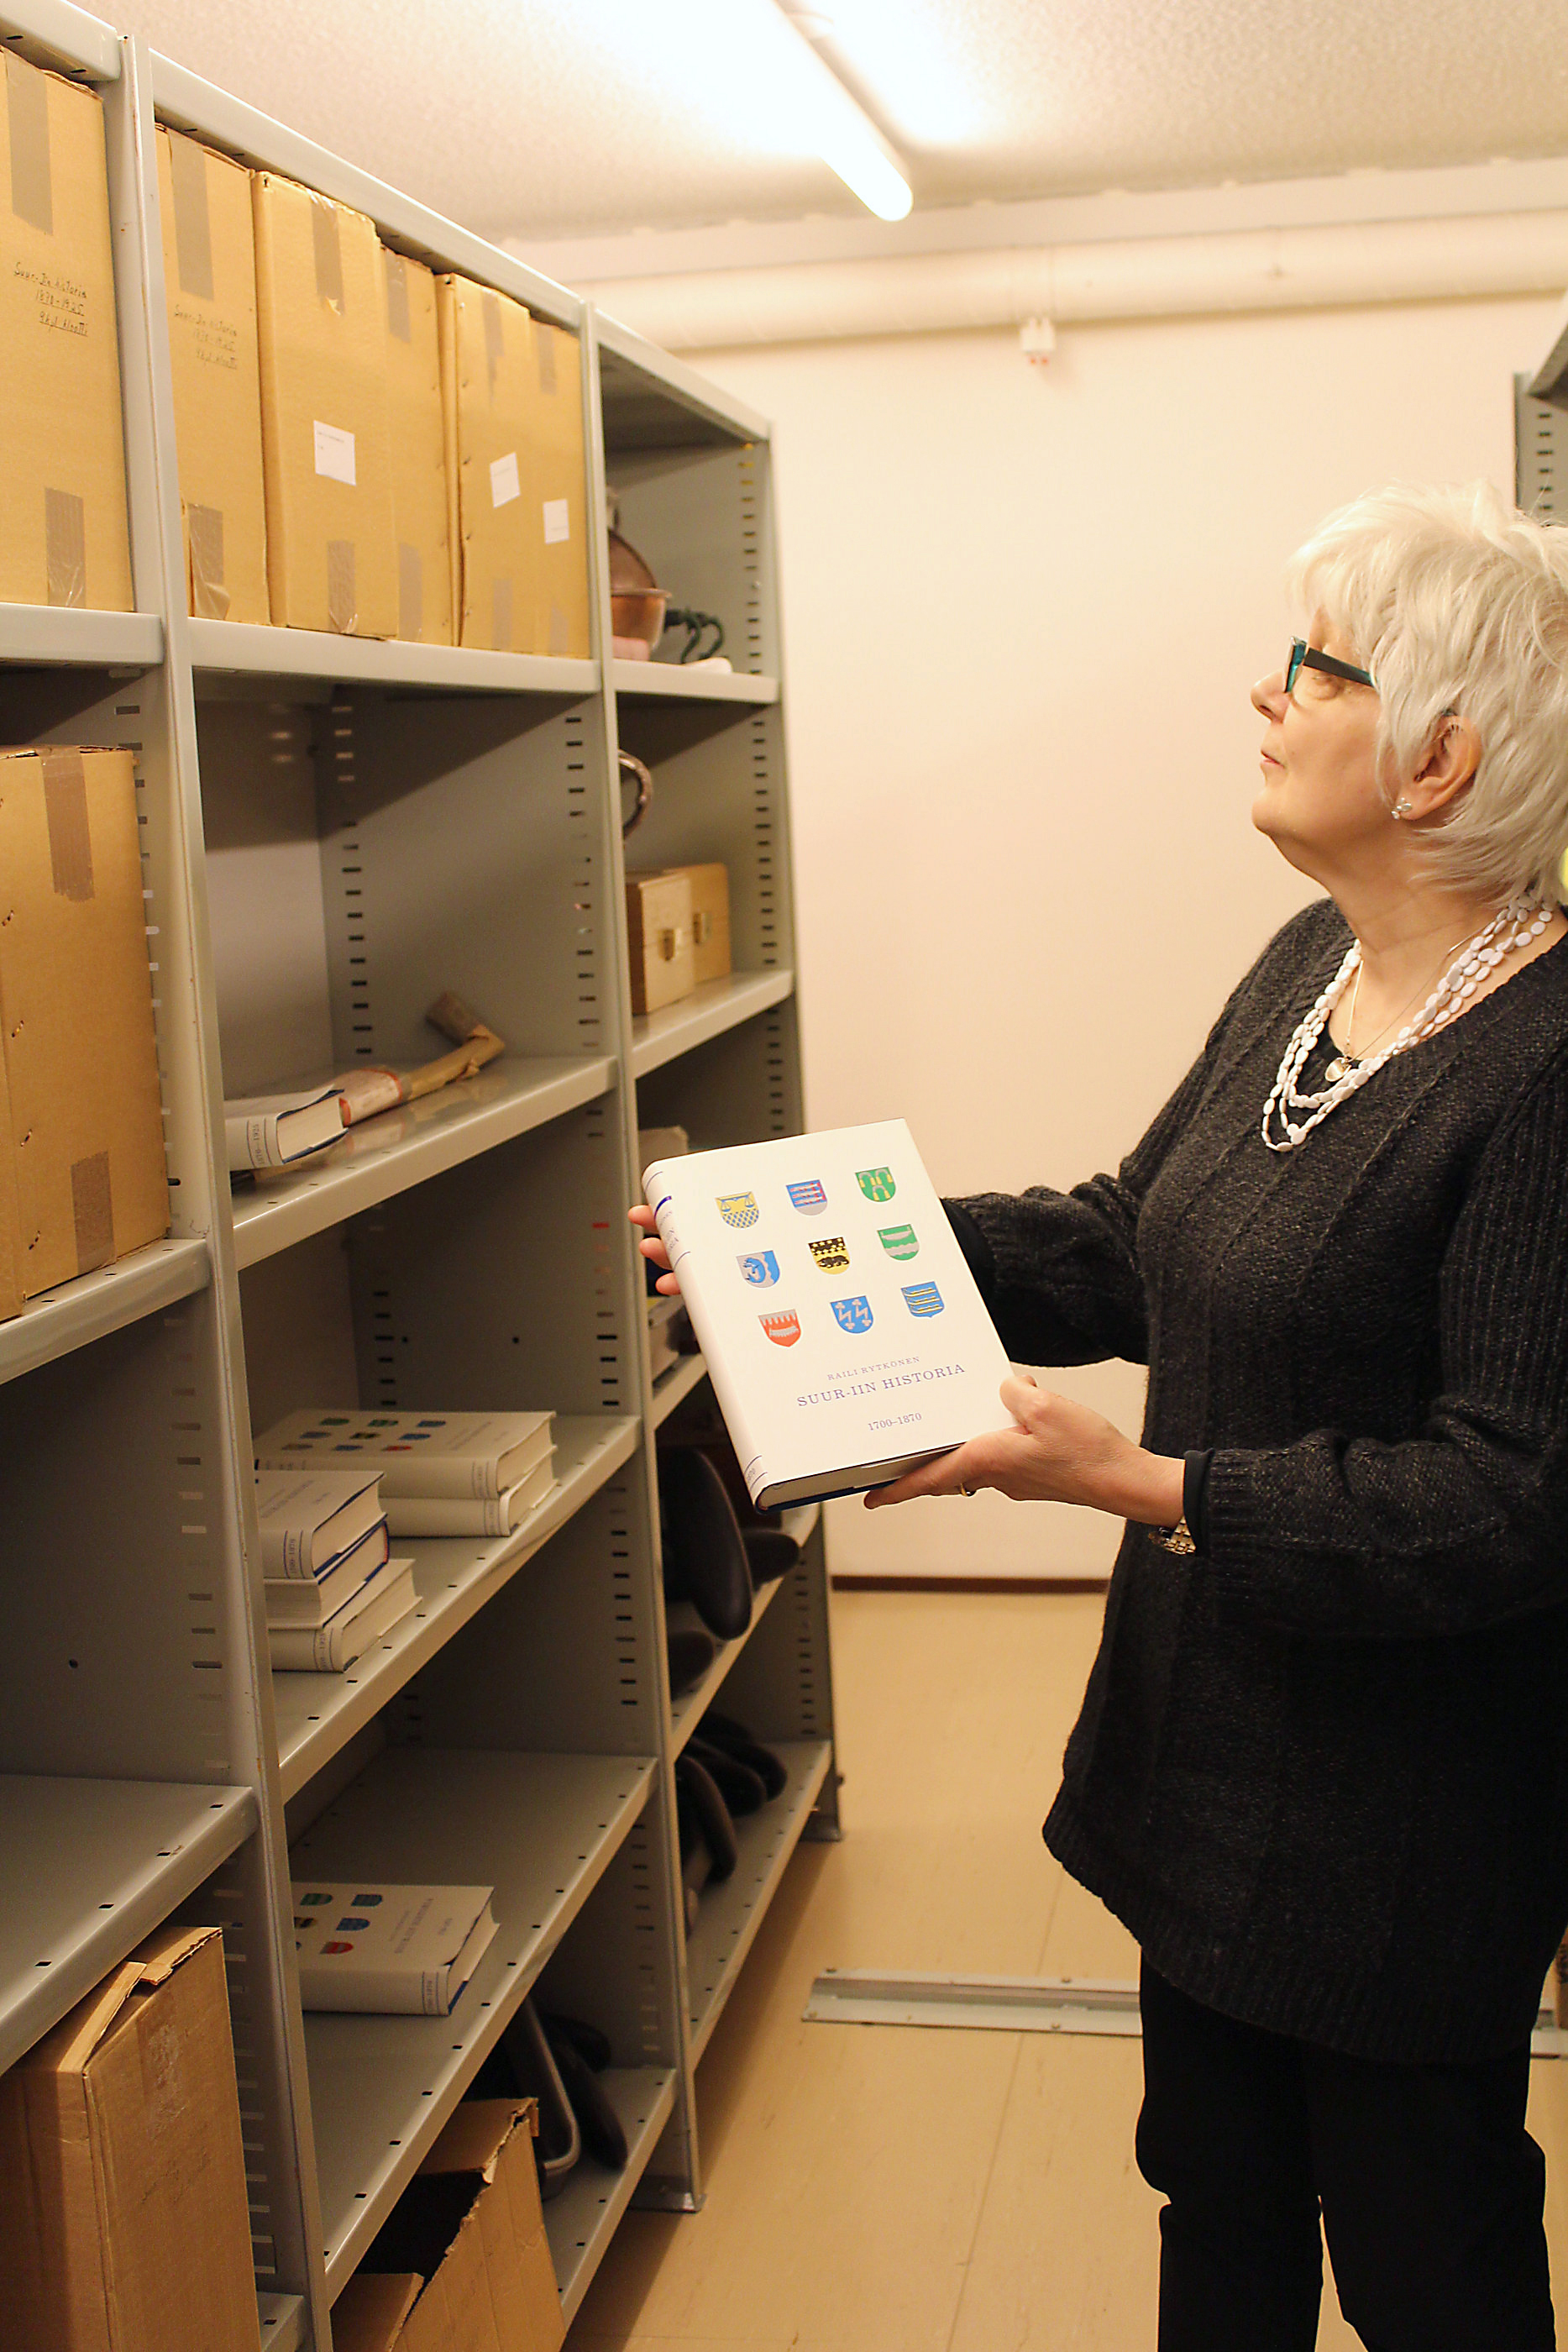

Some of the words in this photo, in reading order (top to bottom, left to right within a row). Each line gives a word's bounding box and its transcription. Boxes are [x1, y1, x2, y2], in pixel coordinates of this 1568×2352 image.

[797, 1382, 878, 1407] SUUR-IIN
[882, 1363, 966, 1390] HISTORIA
[827, 1368, 858, 1381] RAILI
